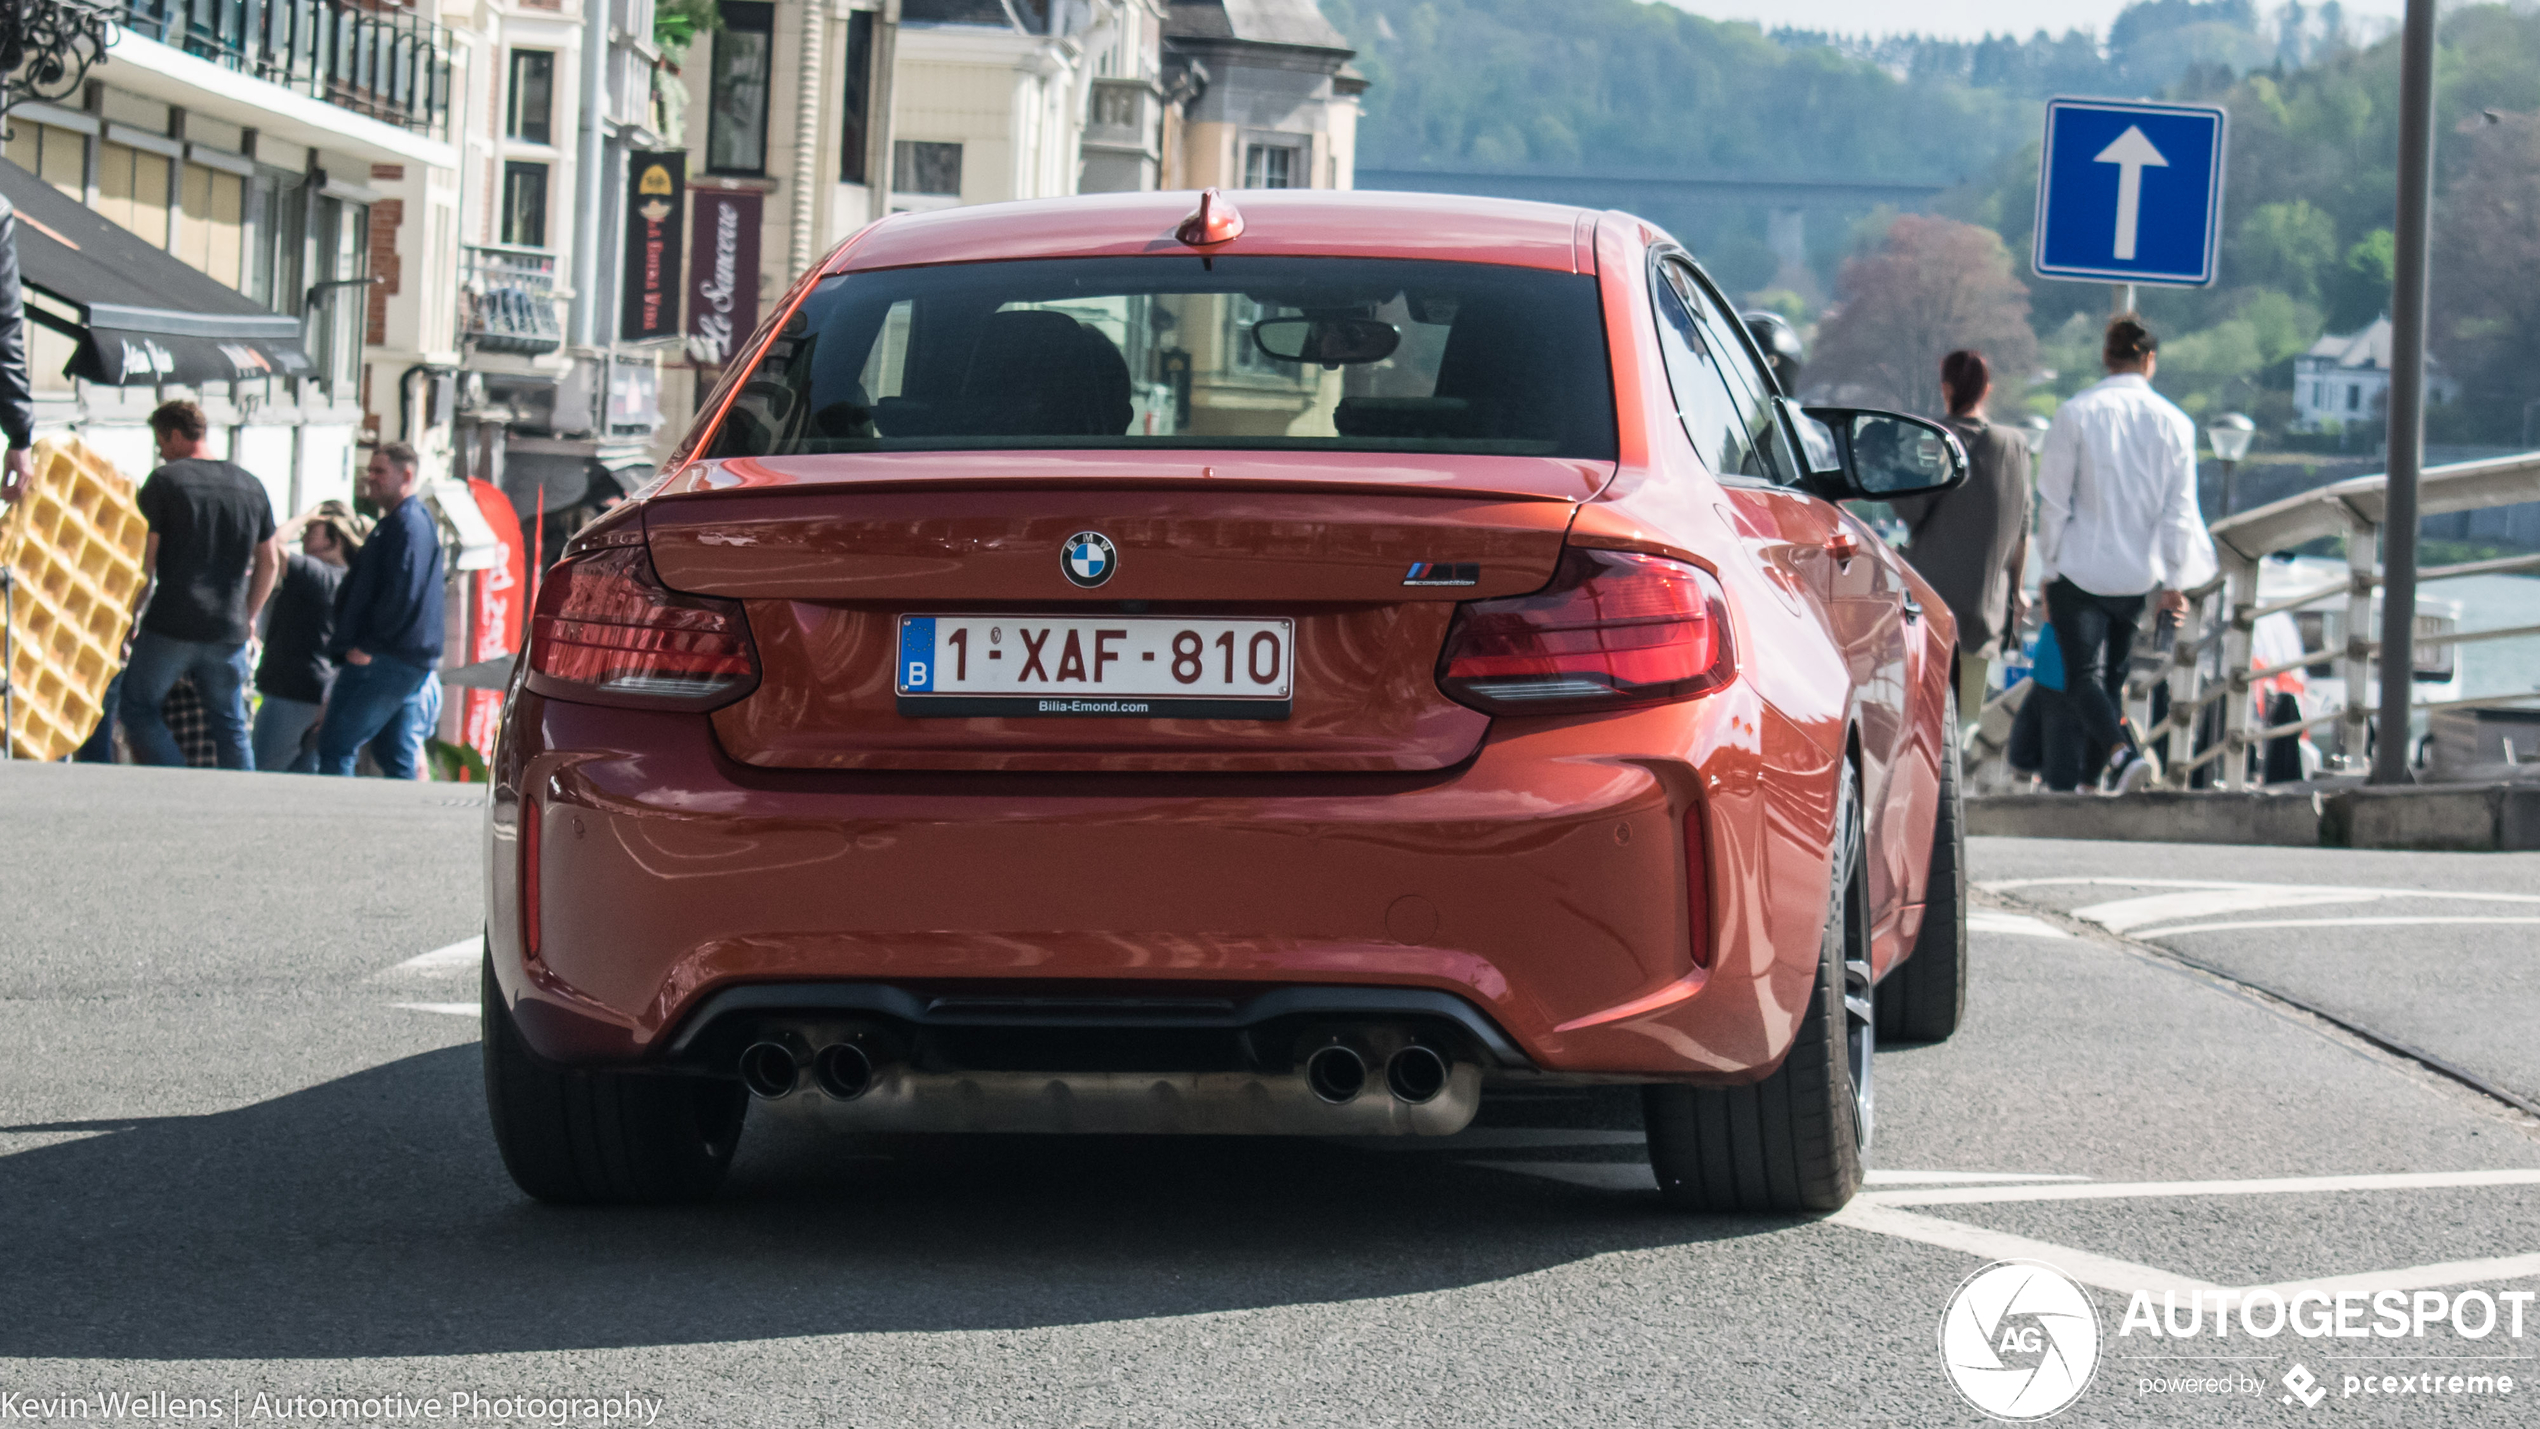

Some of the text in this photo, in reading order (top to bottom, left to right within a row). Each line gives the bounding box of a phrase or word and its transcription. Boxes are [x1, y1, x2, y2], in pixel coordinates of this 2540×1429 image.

[699, 313, 733, 357] Le
[1066, 533, 1112, 551] BMW
[948, 628, 1281, 685] 1-XAF-810
[907, 661, 928, 686] B
[1038, 701, 1149, 713] Bilia-Emond.com
